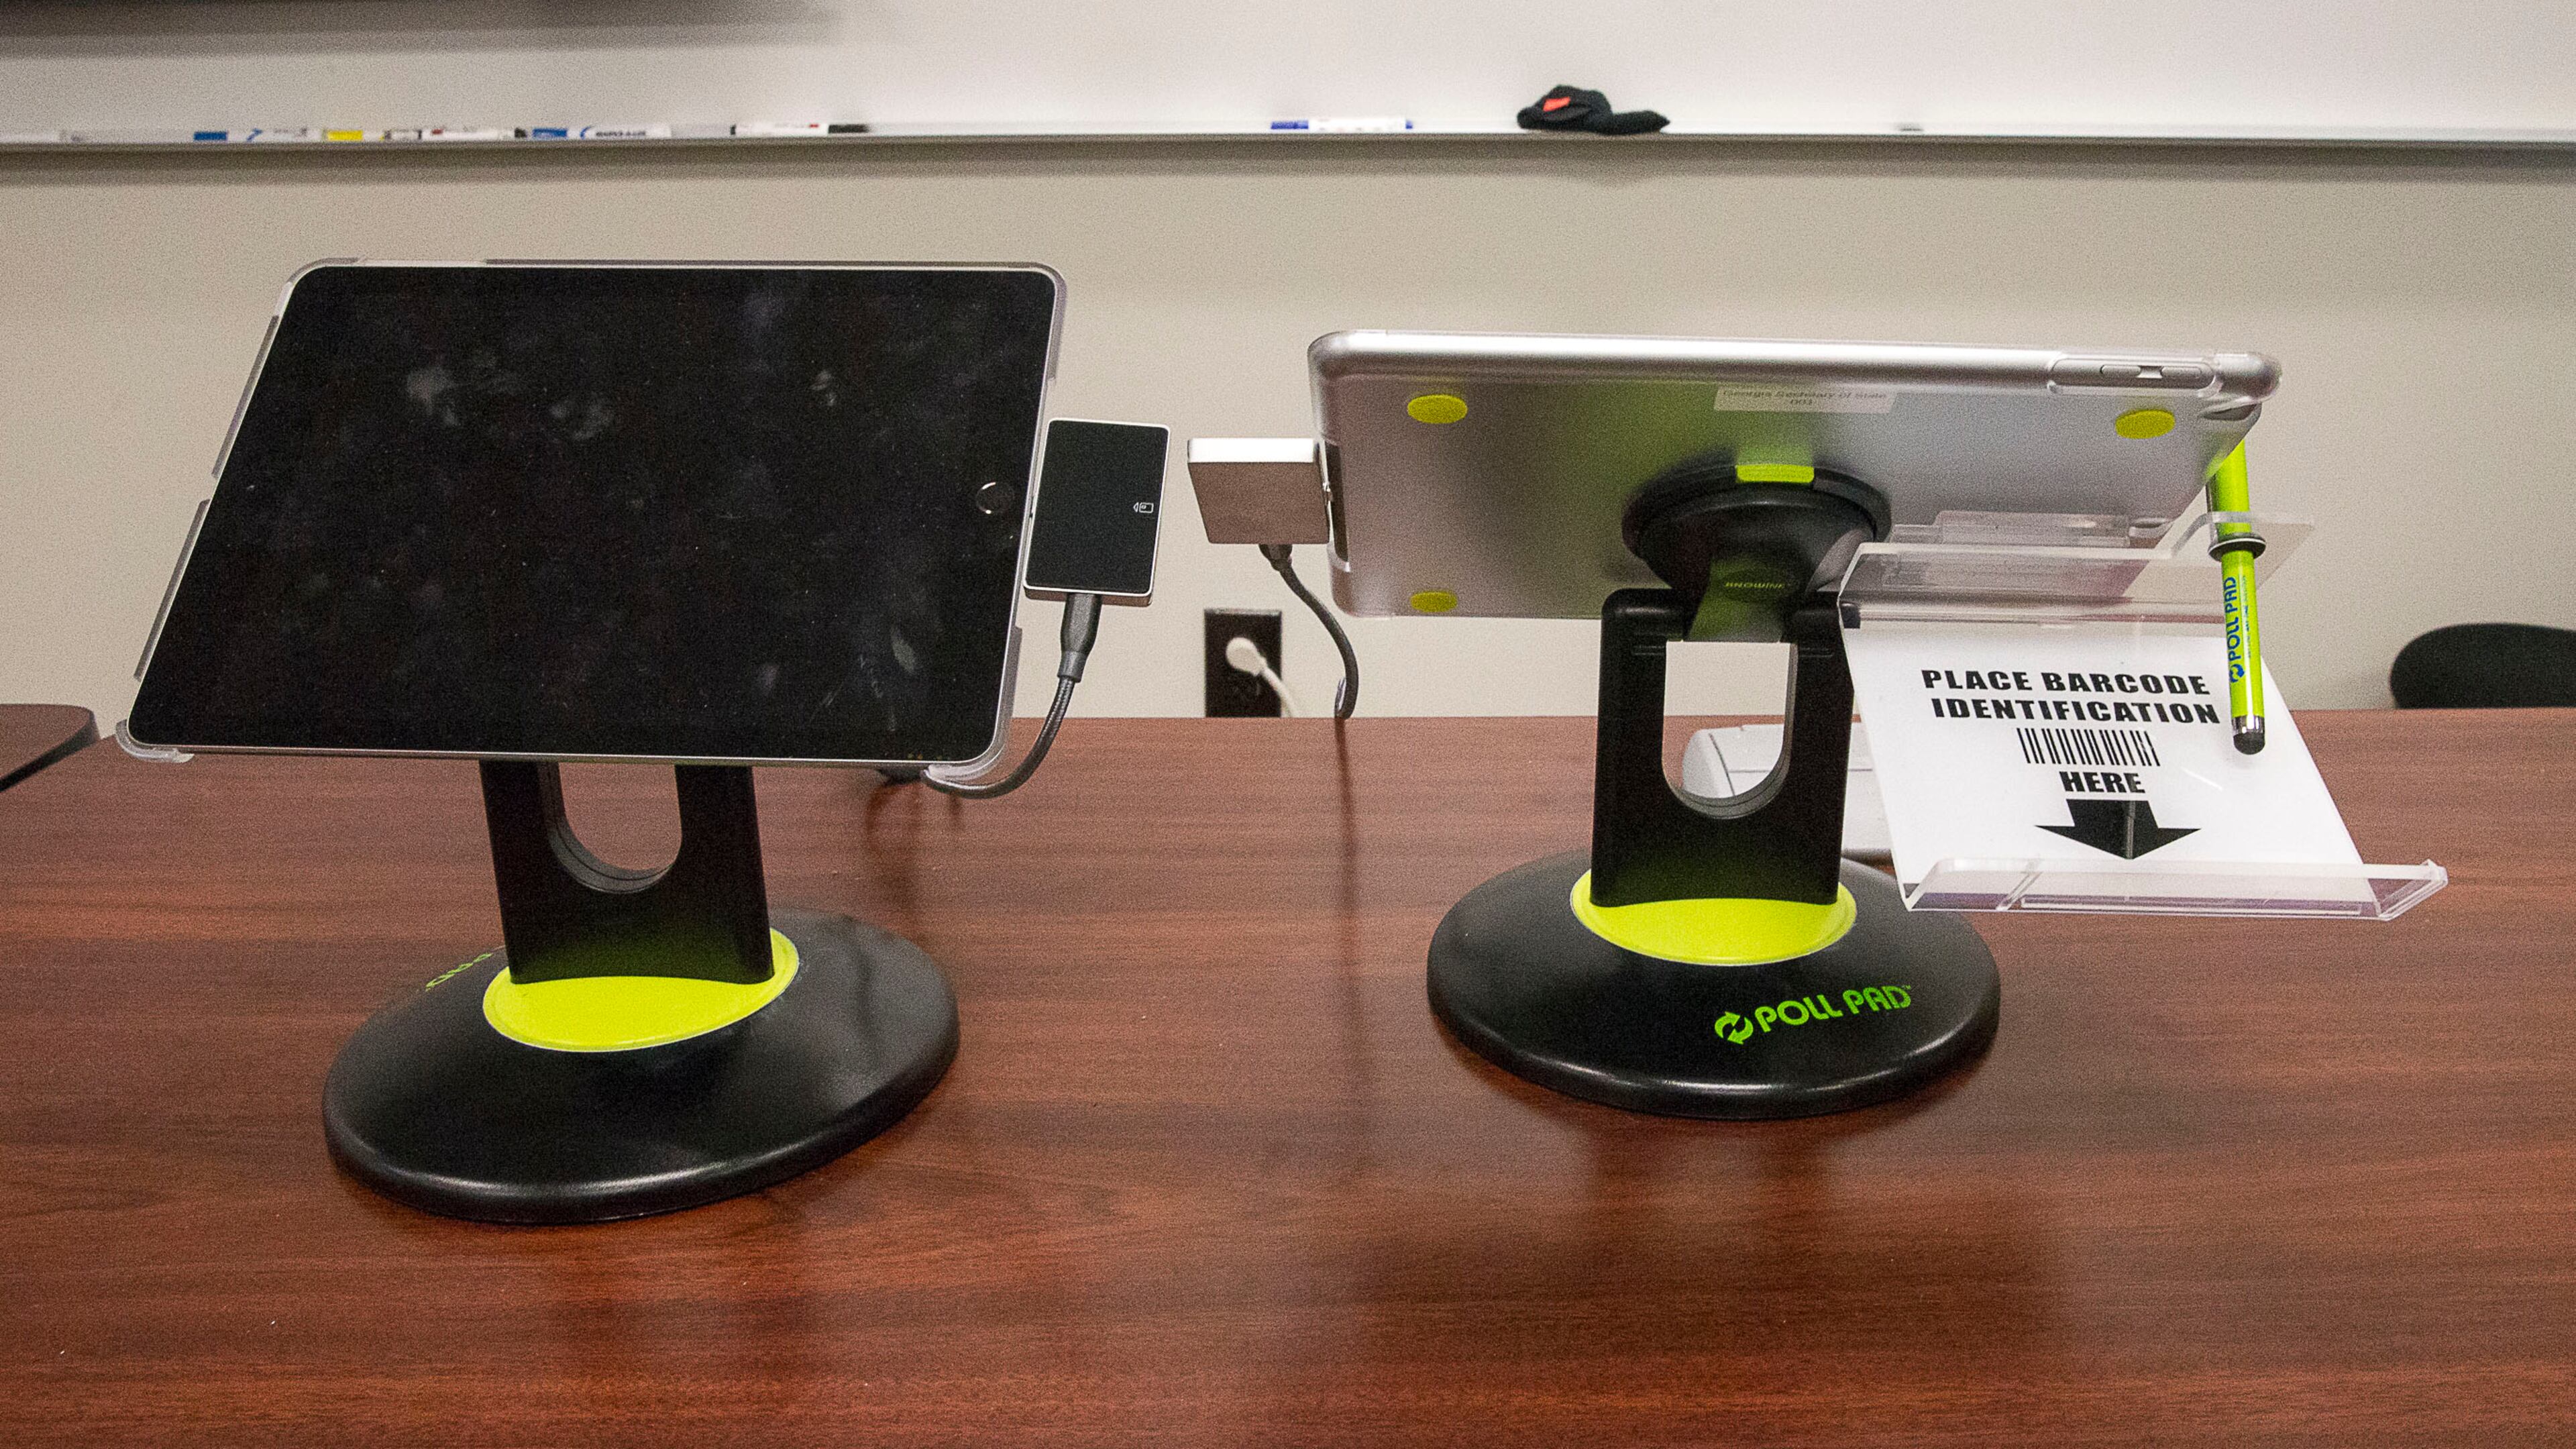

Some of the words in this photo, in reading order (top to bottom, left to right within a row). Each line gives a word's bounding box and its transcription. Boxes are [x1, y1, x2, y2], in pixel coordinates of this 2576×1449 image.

[2222, 576, 2238, 613] PAD
[2226, 616, 2242, 661] POLL
[1921, 669, 2033, 691] PLACE
[2041, 672, 2210, 695] BARCODE
[1931, 698, 2220, 724] IDENTIFICATION
[2058, 771, 2146, 794] HERE
[1754, 994, 1844, 1033] POLL
